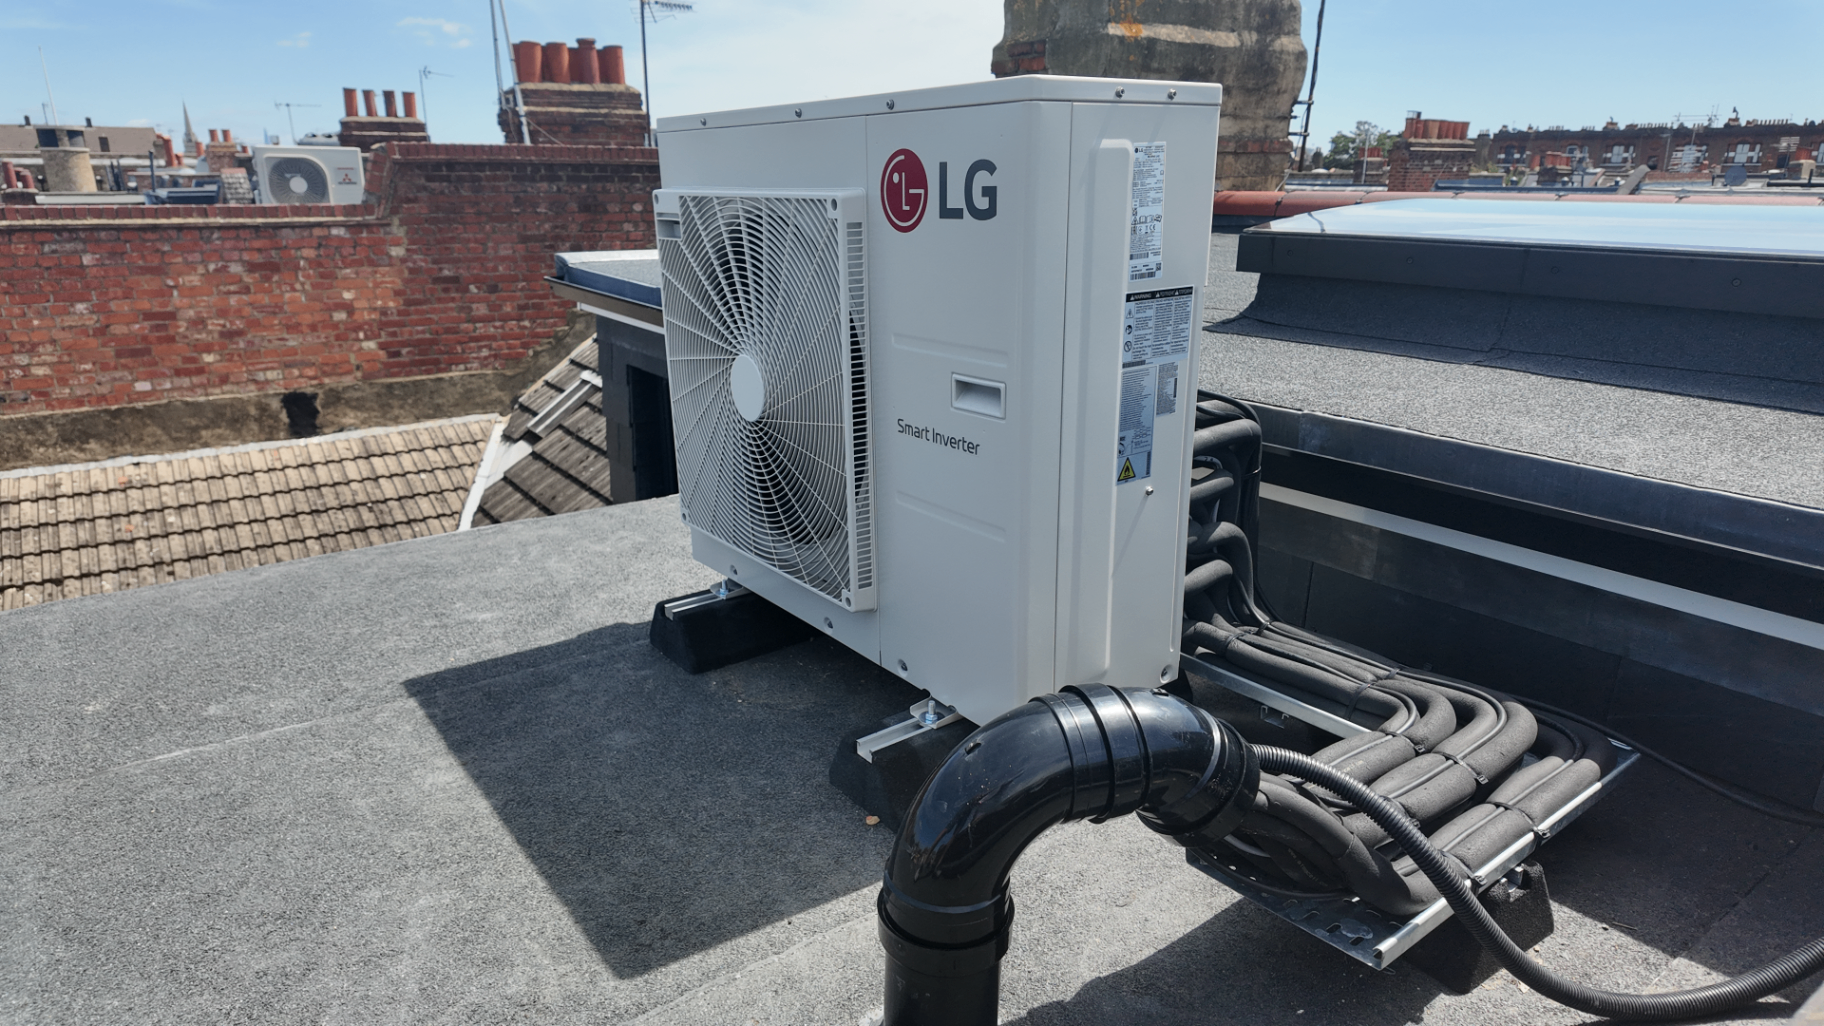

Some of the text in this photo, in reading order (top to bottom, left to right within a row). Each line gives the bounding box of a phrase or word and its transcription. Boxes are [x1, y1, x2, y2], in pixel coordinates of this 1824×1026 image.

[939, 159, 998, 221] LG
[897, 418, 981, 455] Smart Inverter
